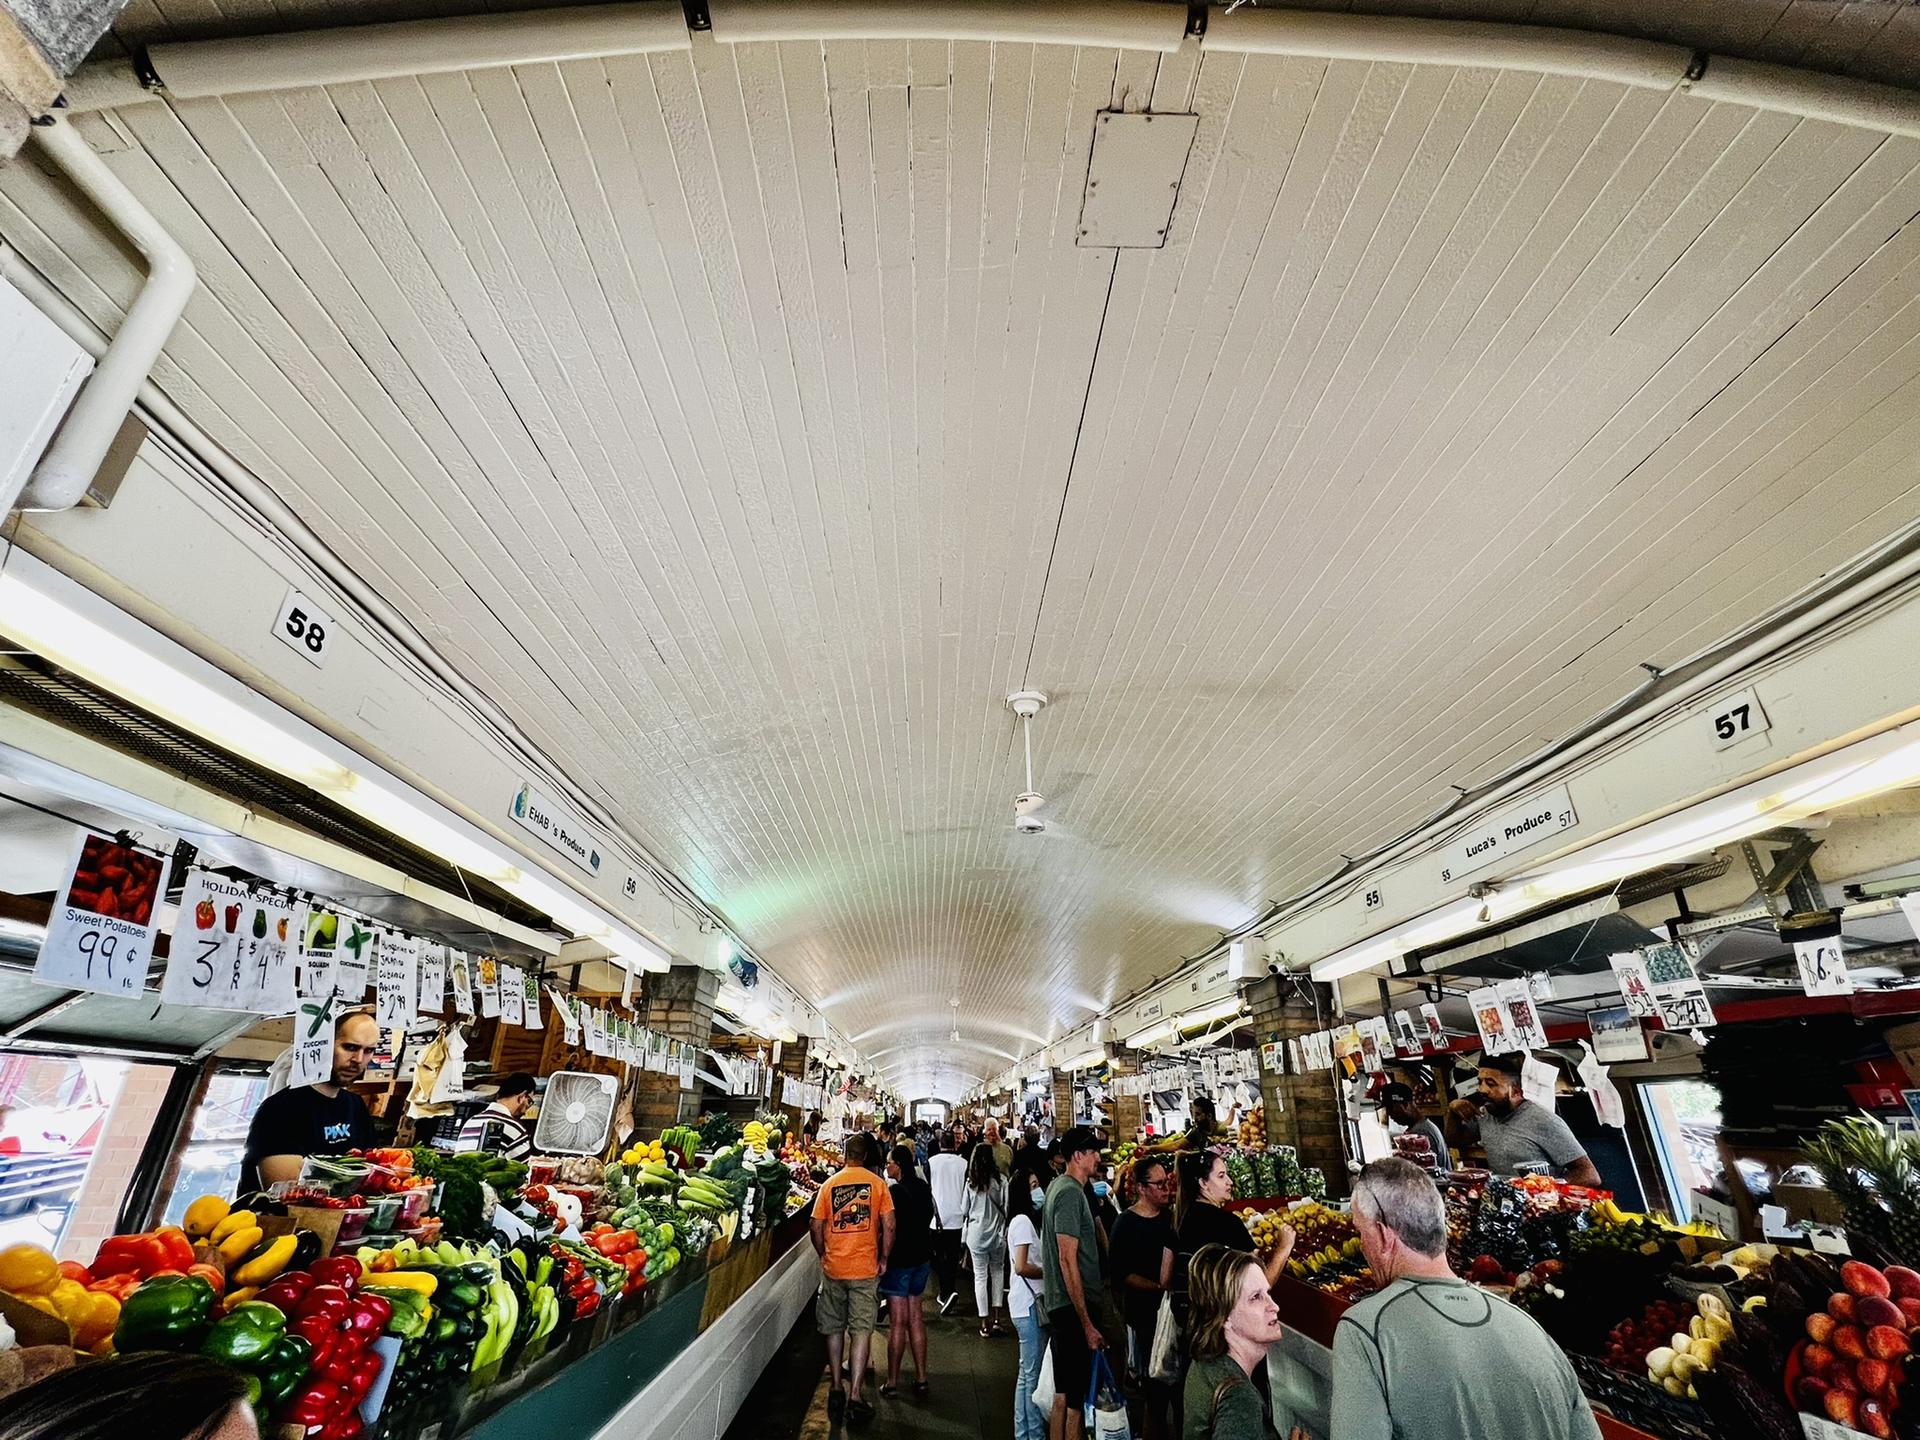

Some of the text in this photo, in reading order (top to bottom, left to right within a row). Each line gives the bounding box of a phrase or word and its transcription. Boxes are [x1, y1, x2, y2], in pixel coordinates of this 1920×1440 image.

[286, 607, 325, 653] 58
[1715, 703, 1750, 740] 57
[528, 806, 550, 830] EHAB
[559, 829, 586, 858] Produce
[1465, 809, 1552, 858] Luca's Produce
[1558, 810, 1572, 828] 57
[626, 876, 637, 895] 56
[1441, 868, 1451, 882] 55
[201, 879, 296, 912] HOLIDAY SPECIAL
[1365, 889, 1379, 907] 55
[65, 908, 147, 939] Sweet Potatoes
[78, 930, 118, 979] 99
